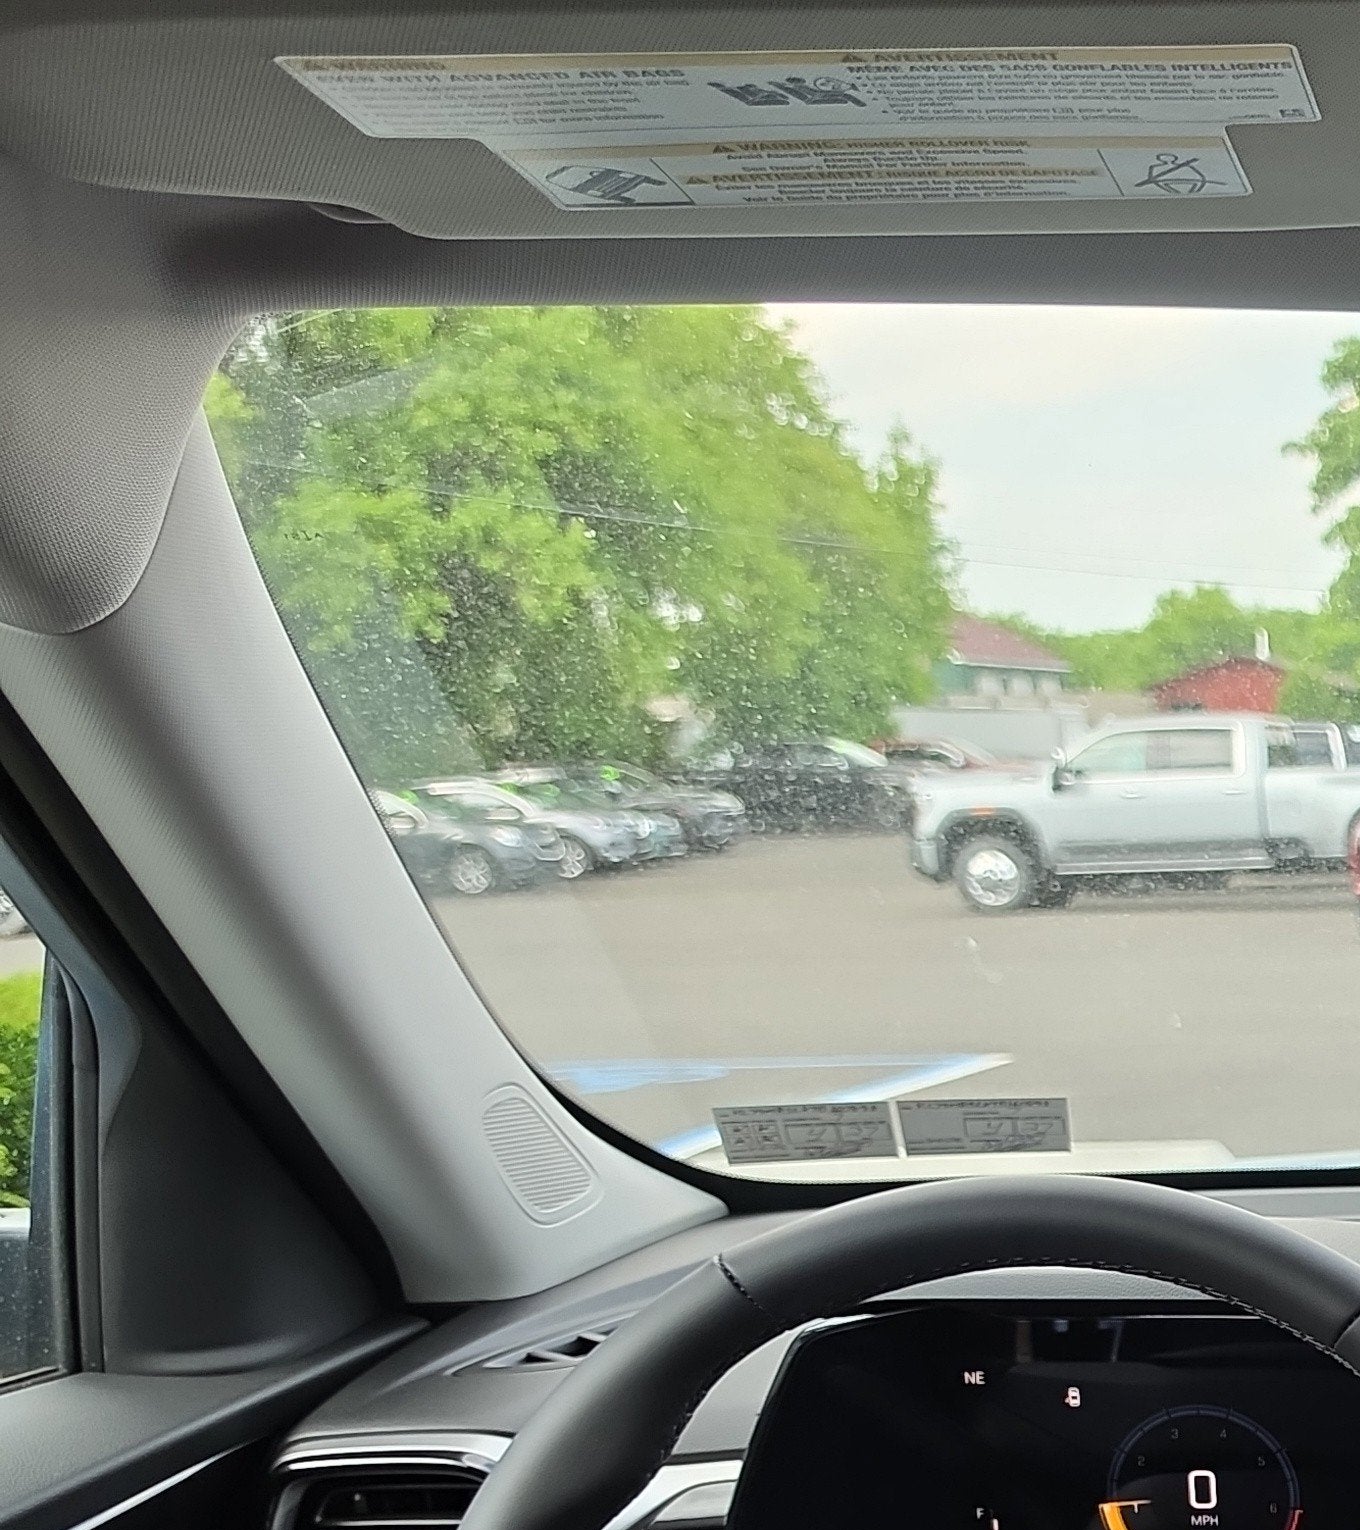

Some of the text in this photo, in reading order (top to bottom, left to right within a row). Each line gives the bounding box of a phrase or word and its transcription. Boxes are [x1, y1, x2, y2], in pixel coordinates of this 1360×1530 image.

[964, 1371, 985, 1386] NE
[1187, 1469, 1218, 1510] 0
[976, 1507, 985, 1520] F
[1190, 1514, 1220, 1528] MPH
